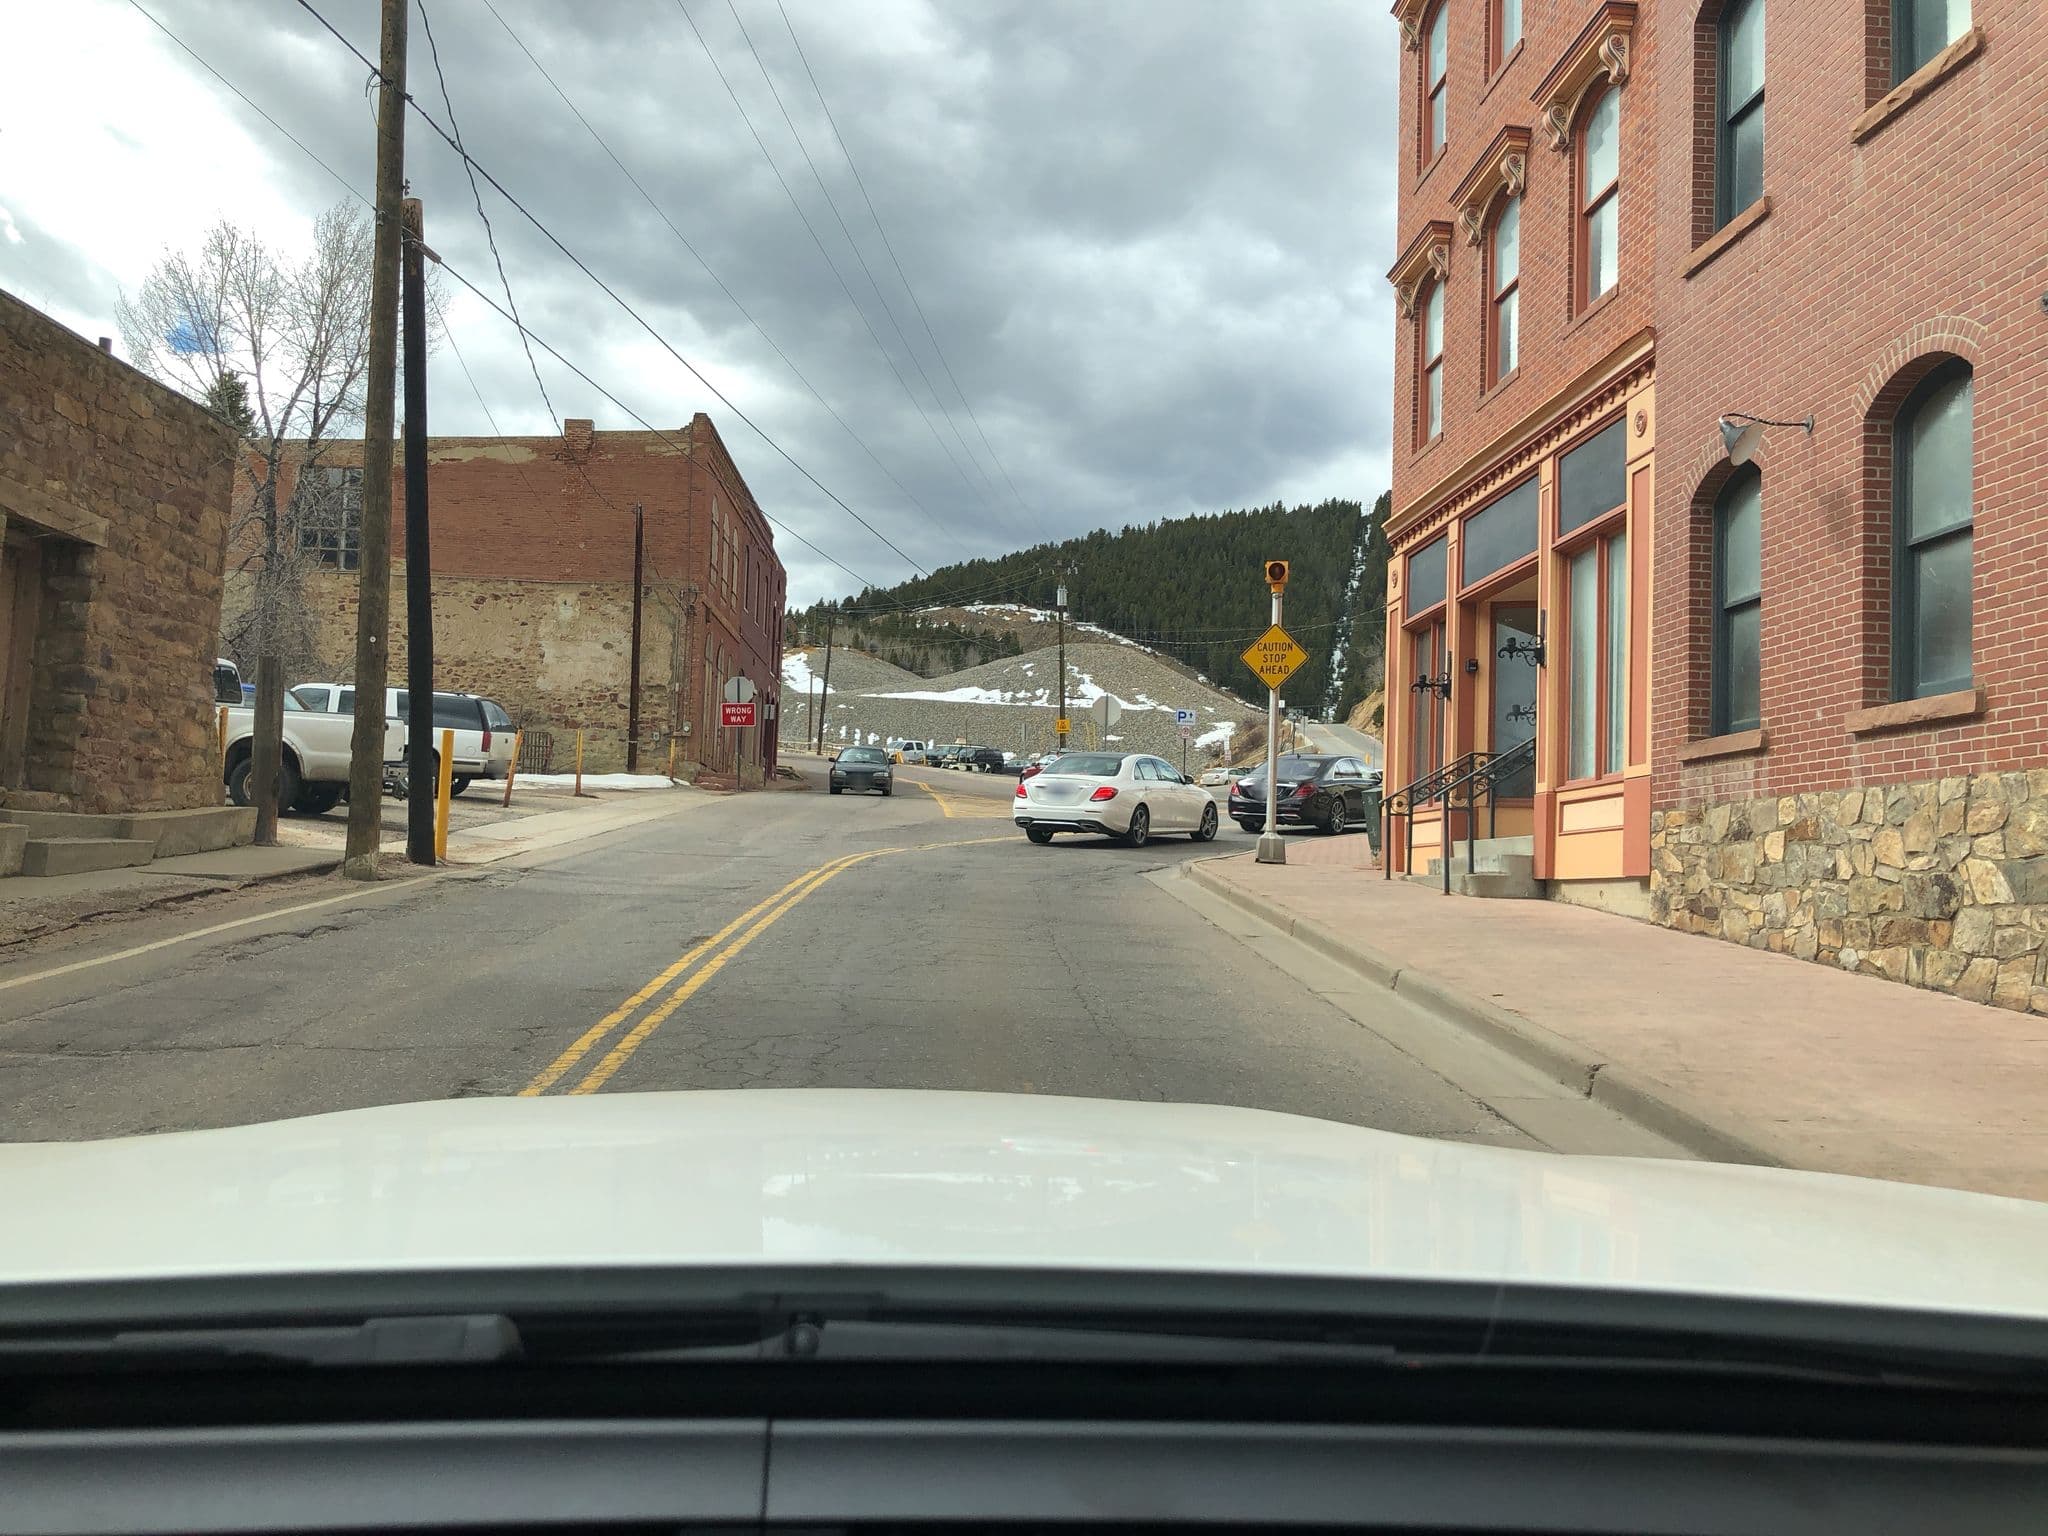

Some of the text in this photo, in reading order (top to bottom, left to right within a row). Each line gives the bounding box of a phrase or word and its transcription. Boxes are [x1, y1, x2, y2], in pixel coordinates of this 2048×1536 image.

[1257, 642, 1293, 651] CAUTION
[1263, 654, 1287, 663] STOP
[1259, 665, 1290, 675] AHEAD
[1178, 711, 1187, 722] P
